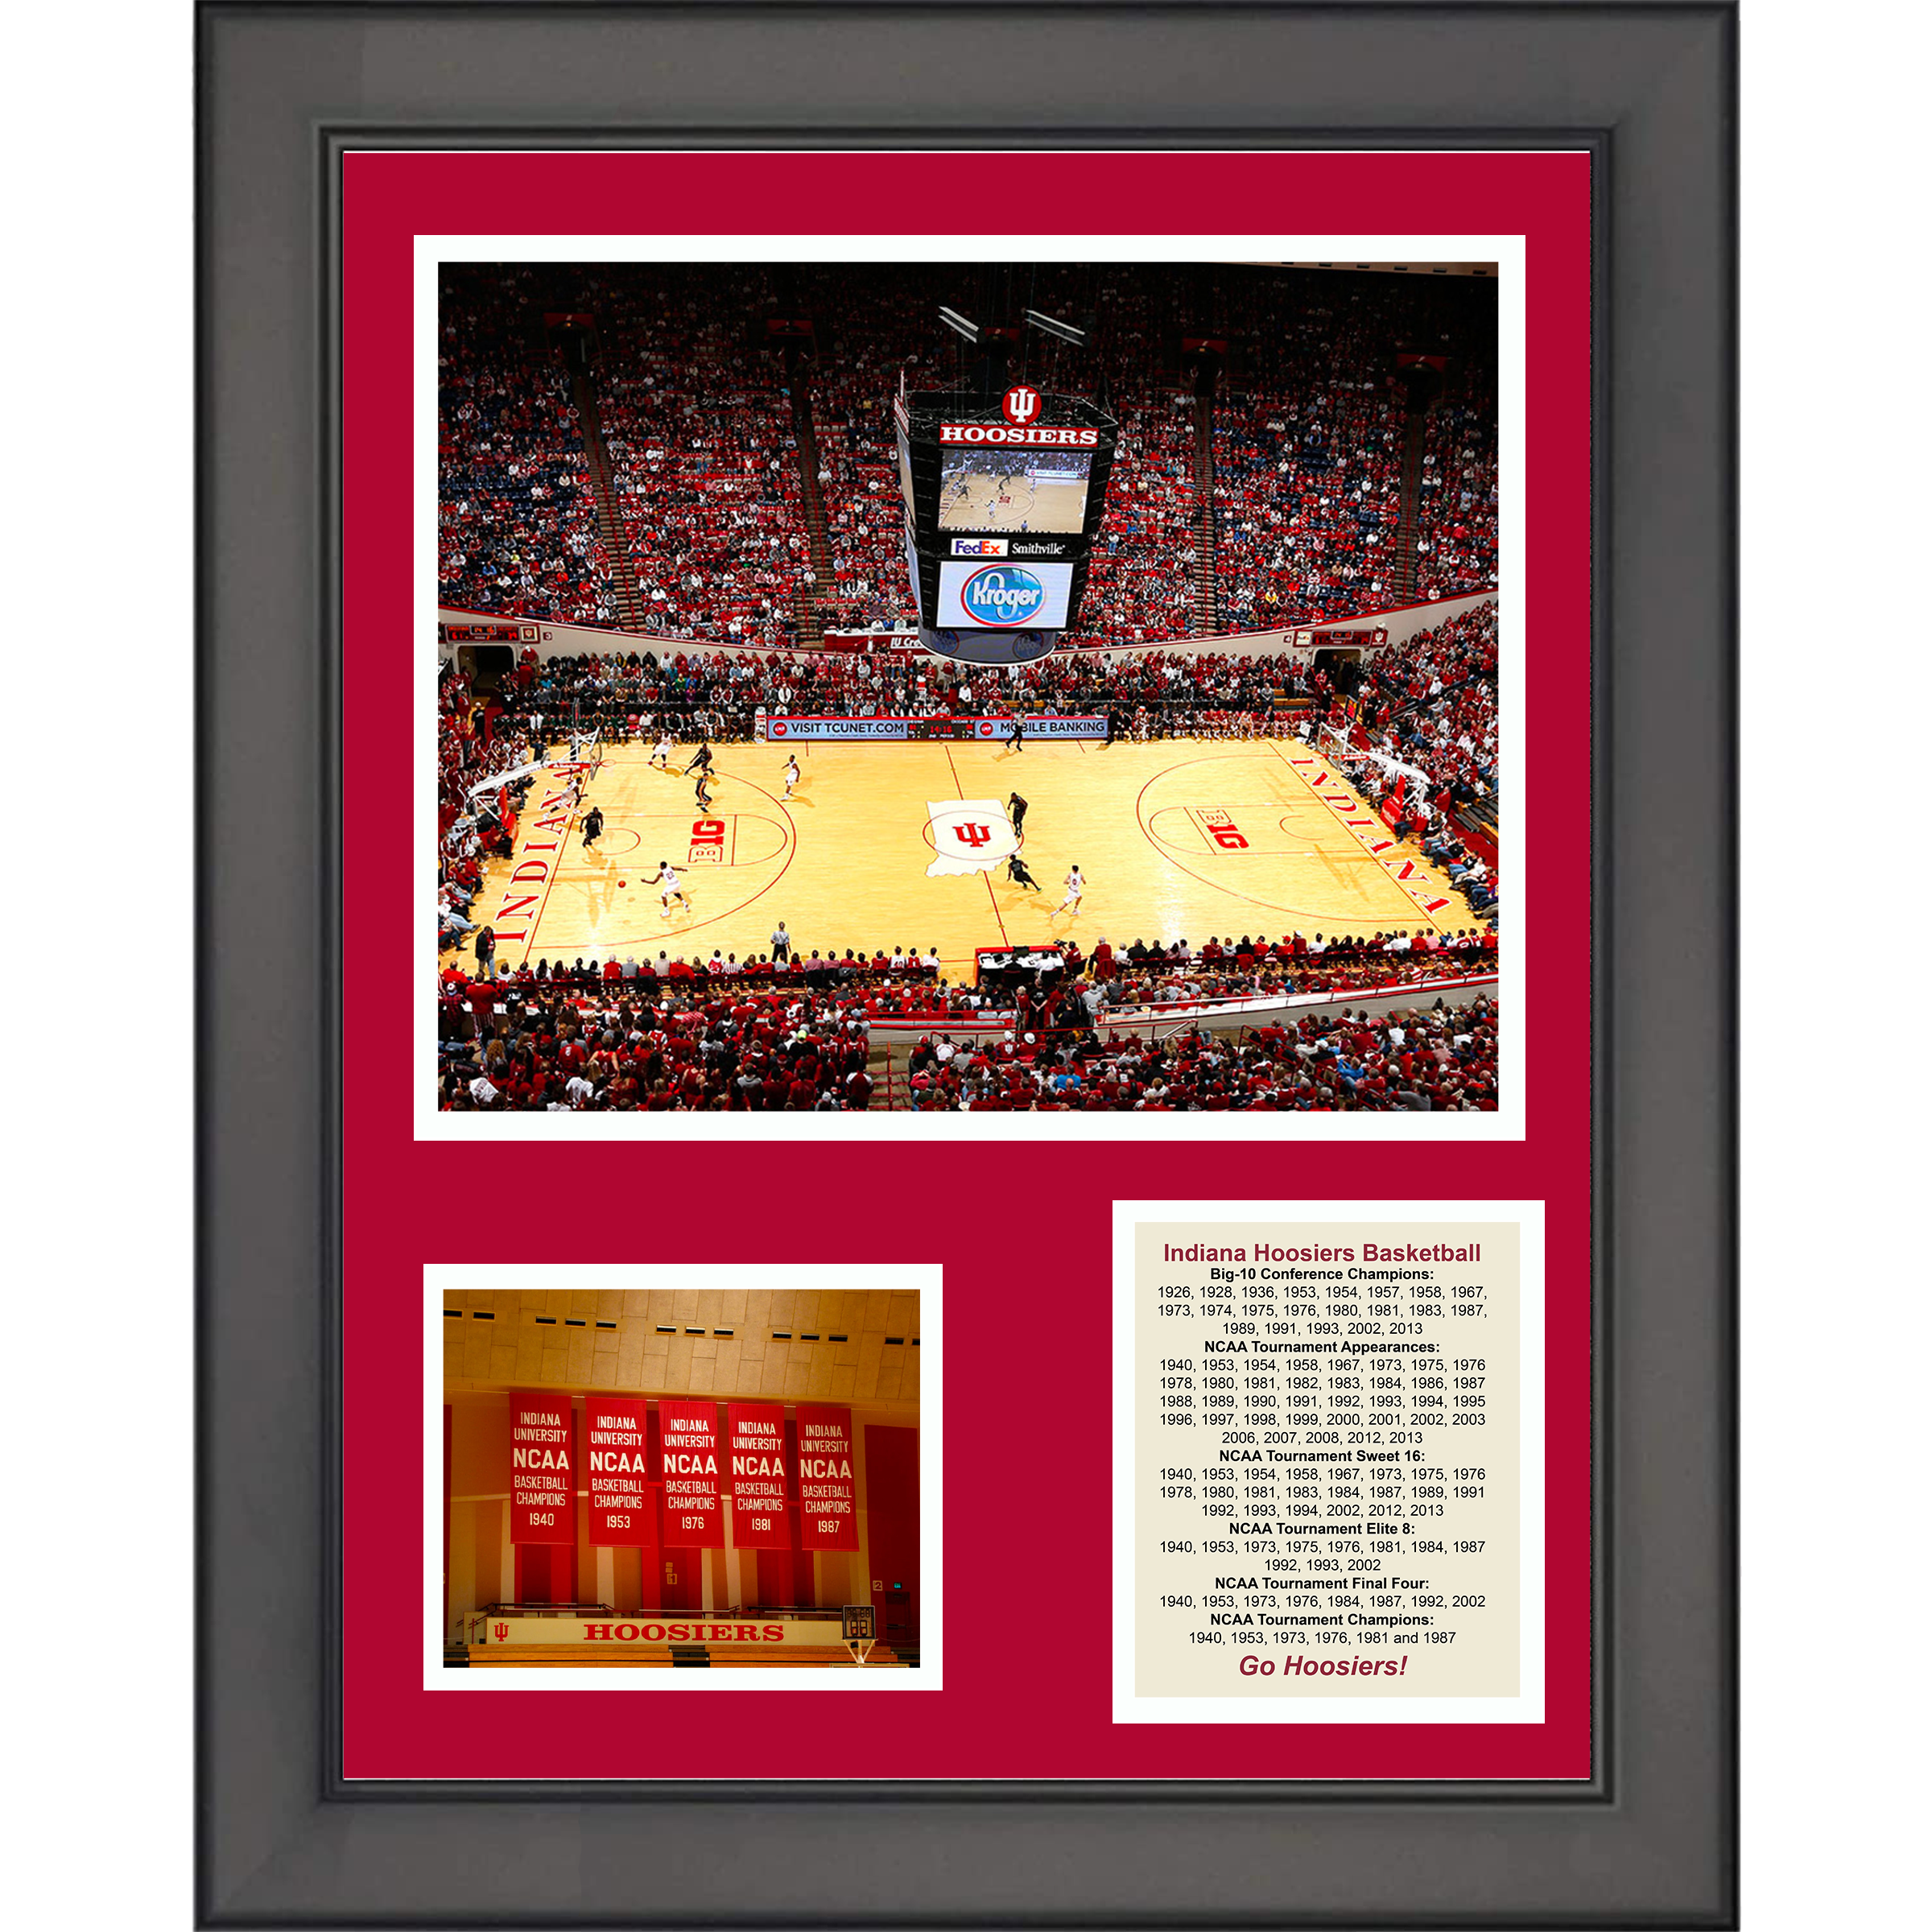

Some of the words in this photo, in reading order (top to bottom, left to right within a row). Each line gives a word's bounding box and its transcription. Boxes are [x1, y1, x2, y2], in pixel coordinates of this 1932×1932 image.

[940, 426, 1098, 445] HOOSIERS
[955, 540, 1001, 555] FedEx
[1012, 543, 1063, 555] Smithville
[972, 572, 1040, 620] Kroger
[791, 723, 821, 733] VISIT
[824, 723, 904, 733] TCUNET.COM
[1050, 722, 1105, 733] BANKING
[1290, 757, 1452, 914] INDIANA
[1164, 1243, 1247, 1262] Indiana
[1254, 1243, 1355, 1262] Hoosiers
[1363, 1243, 1480, 1262] Basketball
[1210, 1267, 1257, 1283] Big-10
[1261, 1267, 1344, 1280] Conference
[1348, 1267, 1434, 1283] Champions:
[1158, 1286, 1195, 1300] 1926,
[1199, 1286, 1236, 1300] 1928,
[1241, 1286, 1278, 1300] 1936,
[1283, 1286, 1320, 1300] 1953,
[1325, 1286, 1362, 1300] 1954,
[1367, 1286, 1404, 1300] 1957,
[1409, 1286, 1446, 1300] 1958,
[1451, 1286, 1488, 1300] 1967,
[1158, 1304, 1195, 1319] 1973,
[1199, 1304, 1236, 1319] 1974,
[1241, 1304, 1278, 1319] 1975,
[1283, 1304, 1320, 1319] 1976,
[1325, 1304, 1362, 1319] 1980,
[1367, 1304, 1404, 1319] 1981,
[1409, 1304, 1446, 1319] 1983,
[1451, 1304, 1488, 1319] 1987,
[1223, 1322, 1259, 1337] 1989,
[1265, 1322, 1301, 1337] 1991,
[1307, 1322, 1343, 1337] 1993,
[1347, 1322, 1385, 1337] 2002,
[1389, 1322, 1423, 1335] 2013
[1204, 1340, 1249, 1353] NCAA
[1251, 1340, 1338, 1353] Tournament
[1340, 1340, 1440, 1356] Appearances:
[1160, 1358, 1196, 1373] 1940,
[1202, 1358, 1238, 1373] 1953,
[1244, 1358, 1280, 1373] 1954,
[1286, 1358, 1322, 1373] 1958,
[1327, 1358, 1364, 1373] 1967,
[1369, 1358, 1406, 1373] 1973,
[1411, 1358, 1447, 1373] 1975,
[1453, 1358, 1486, 1371] 1976
[1160, 1395, 1196, 1410] 1988,
[1202, 1395, 1238, 1410] 1989,
[1244, 1395, 1280, 1410] 1990,
[1286, 1395, 1322, 1410] 1991,
[1327, 1395, 1364, 1410] 1992,
[1369, 1395, 1406, 1410] 1993,
[1411, 1395, 1447, 1410] 1994,
[1453, 1395, 1486, 1407] 1995
[521, 1412, 561, 1426] INDIANA
[597, 1415, 637, 1430] INDIANA
[671, 1418, 709, 1432] INDIANA
[514, 1427, 568, 1443] UNIVERSITY
[738, 1422, 776, 1435] INDIANA
[805, 1424, 843, 1438] INDIANA
[591, 1431, 642, 1446] UNIVERSITY
[664, 1435, 715, 1448] UNIVERSITY
[733, 1436, 782, 1451] UNIVERSITY
[801, 1439, 848, 1453] UNIVERSITY
[1221, 1431, 1259, 1446] 2006,
[1263, 1431, 1301, 1446] 2007,
[1305, 1431, 1343, 1446] 2008,
[1347, 1431, 1385, 1446] 2012,
[1389, 1431, 1423, 1444] 2013
[514, 1447, 570, 1470] NCAA
[590, 1451, 646, 1473] NCAA
[1220, 1449, 1263, 1462] NCAA
[1265, 1449, 1352, 1462] Tournament
[1356, 1449, 1400, 1462] Sweet
[1404, 1449, 1425, 1462] 16:
[663, 1454, 718, 1474] NCAA
[733, 1455, 785, 1476] NCAA
[800, 1459, 852, 1479] NCAA
[514, 1475, 568, 1490] BASKETBALL
[592, 1478, 644, 1492] BASKETBALL
[666, 1480, 716, 1493] BASKETBALL
[735, 1482, 784, 1496] BASKETBALL
[803, 1484, 852, 1497] BASKETBALL
[516, 1492, 566, 1506] CHAMPIONS
[594, 1495, 642, 1509] CHAMPIONS
[668, 1496, 715, 1510] CHAMPIONS
[737, 1498, 783, 1511] CHAMPIONS
[805, 1501, 851, 1513] CHAMPIONS
[1202, 1504, 1238, 1519] 1992,
[1244, 1504, 1280, 1519] 1993,
[1286, 1504, 1322, 1519] 1994,
[1326, 1504, 1364, 1519] 2002,
[1368, 1504, 1406, 1519] 2012,
[1410, 1504, 1444, 1517] 2013
[529, 1513, 555, 1526] 1940
[607, 1515, 630, 1529] 1953
[682, 1517, 704, 1530] 1976
[752, 1517, 771, 1531] 1981
[818, 1520, 840, 1534] 1987
[1229, 1522, 1274, 1535] NCAA
[1275, 1522, 1363, 1535] Tournament
[1366, 1522, 1398, 1535] Elite
[1402, 1522, 1415, 1535] 8:
[1215, 1576, 1259, 1589] NCAA
[1261, 1577, 1348, 1590] Tournament
[1352, 1577, 1387, 1590] Final
[1391, 1577, 1429, 1590] Four:
[1160, 1595, 1196, 1610] 1940,
[1202, 1595, 1238, 1610] 1953,
[1244, 1595, 1280, 1610] 1973,
[1286, 1595, 1322, 1610] 1976,
[1327, 1595, 1364, 1610] 1984,
[1369, 1595, 1406, 1610] 1987,
[1411, 1595, 1447, 1610] 1992,
[1451, 1595, 1486, 1608] 2002
[1210, 1613, 1254, 1626] NCAA
[1257, 1613, 1344, 1626] Tournament
[1348, 1613, 1434, 1629] Champions:
[584, 1623, 785, 1642] HOOSIERS
[1189, 1631, 1226, 1646] 1940,
[1231, 1631, 1268, 1646] 1953,
[1273, 1631, 1310, 1646] 1973,
[1315, 1631, 1352, 1646] 1976,
[1356, 1631, 1388, 1644] 1981
[1393, 1631, 1418, 1644] and
[1423, 1631, 1456, 1644] 1987
[1239, 1654, 1276, 1676] Go
[1283, 1655, 1408, 1676] Hoosiers!
